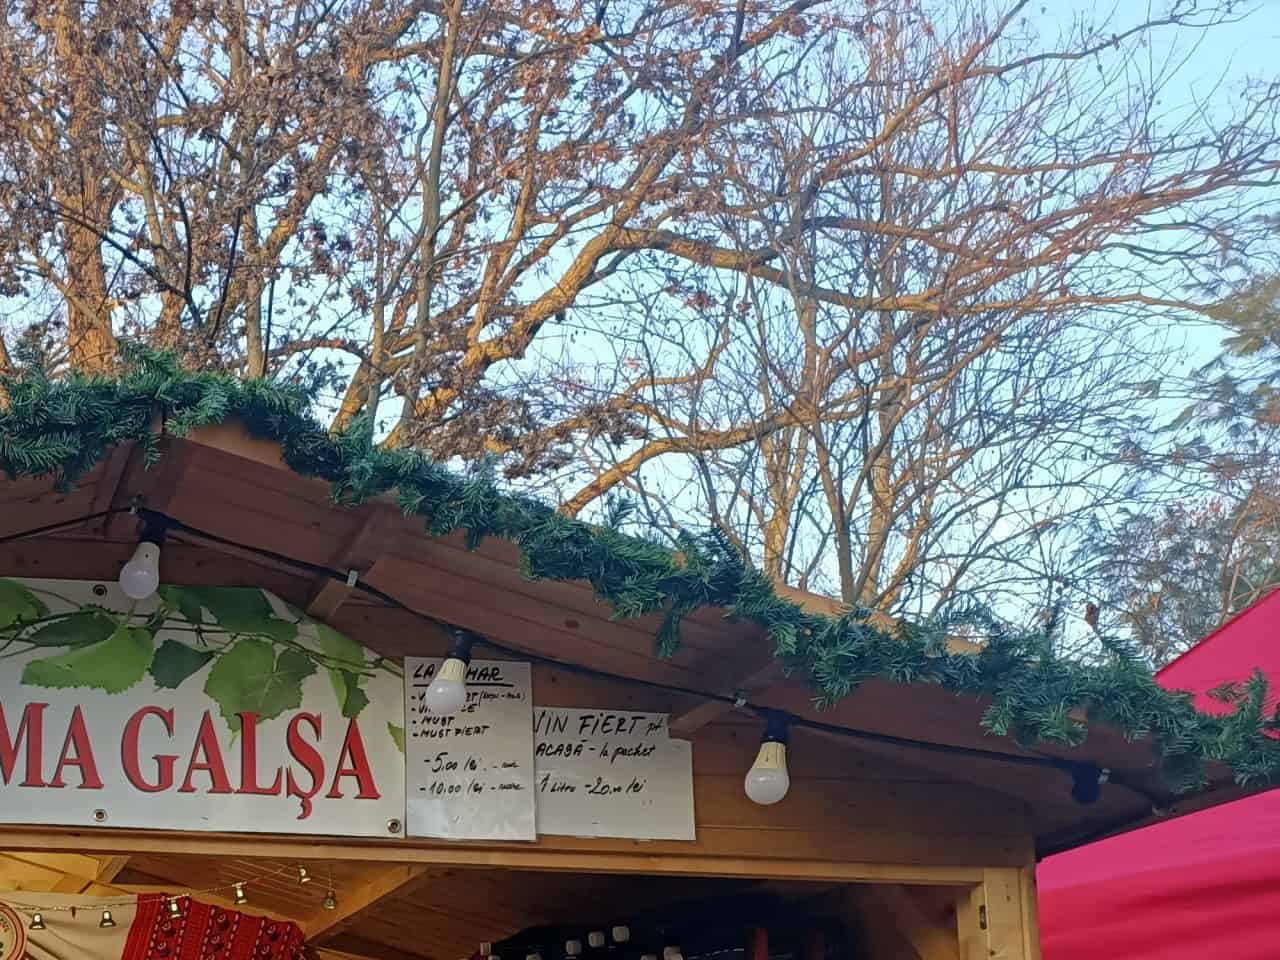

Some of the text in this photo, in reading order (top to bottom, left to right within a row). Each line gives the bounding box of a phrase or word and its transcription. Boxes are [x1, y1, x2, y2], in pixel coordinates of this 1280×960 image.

[413, 664, 436, 679] LA
[421, 716, 456, 727] MUST
[579, 713, 647, 736] FIERT
[420, 728, 451, 738] MUST
[121, 704, 382, 820] GALȘA
[540, 773, 551, 793] 1
[625, 776, 647, 793] lei
